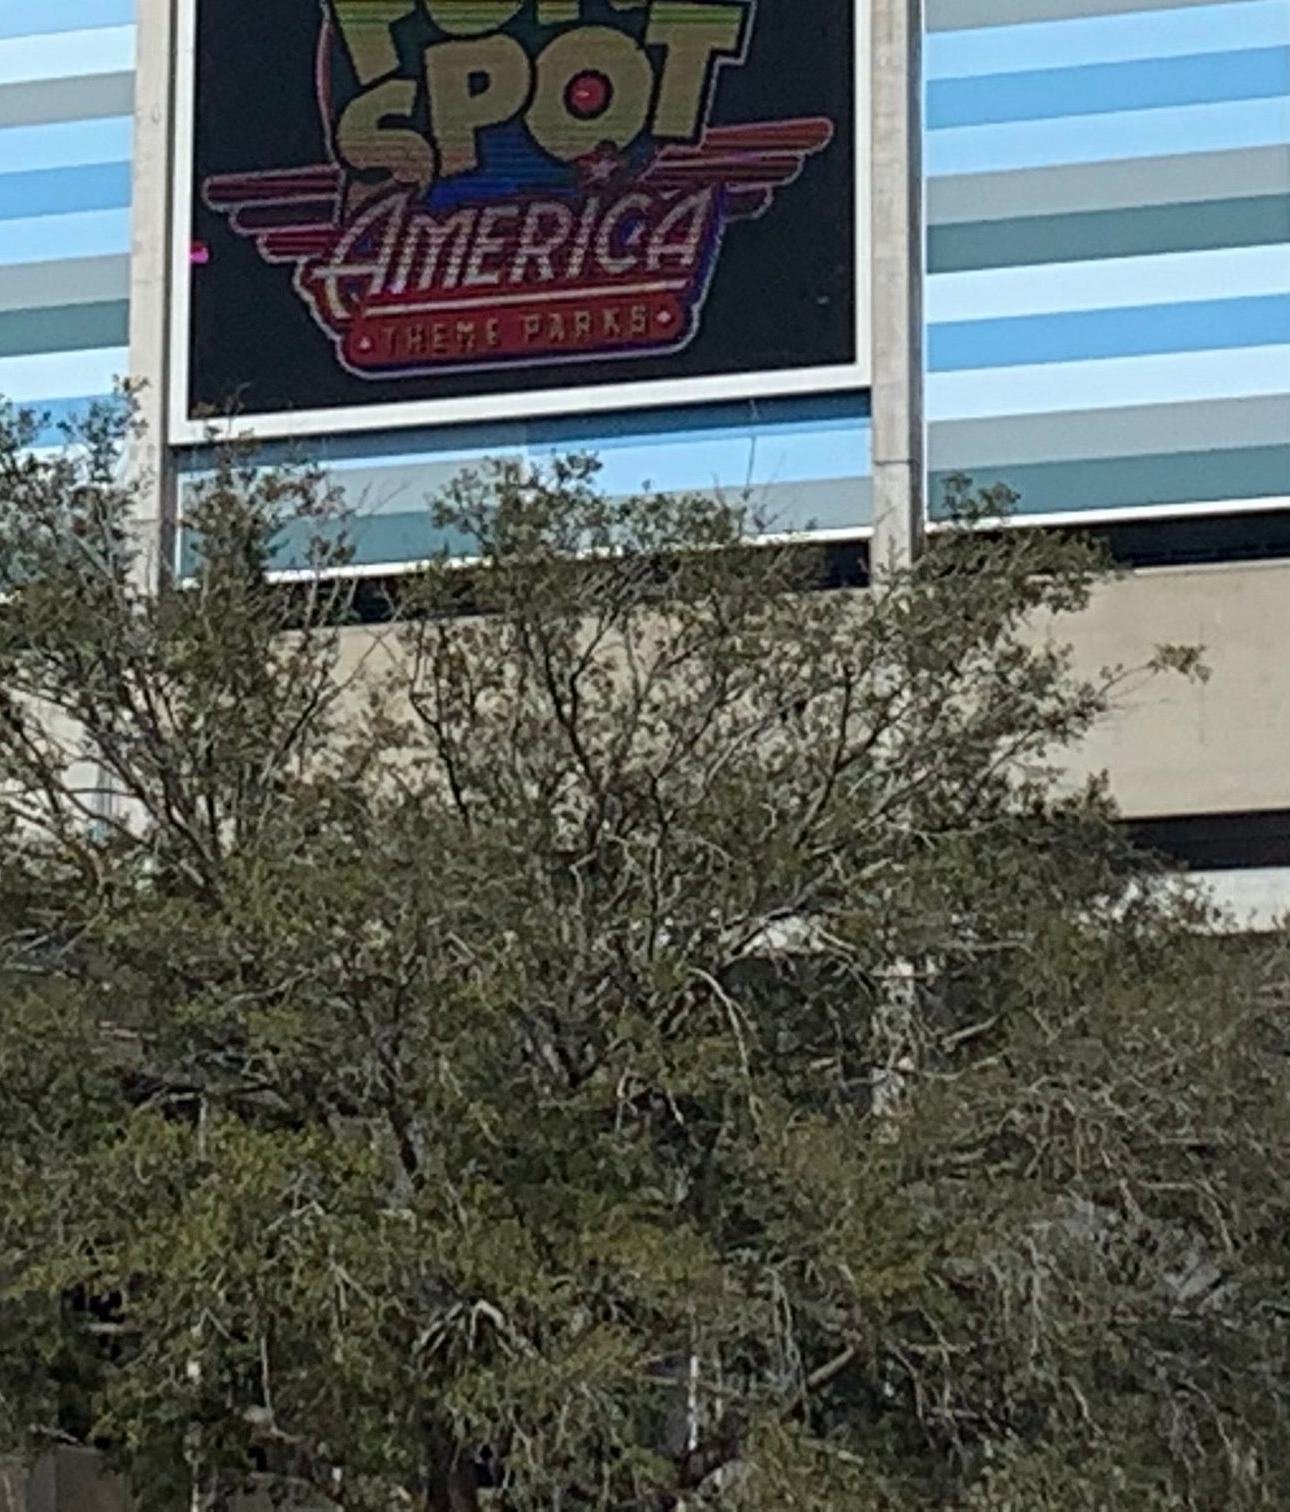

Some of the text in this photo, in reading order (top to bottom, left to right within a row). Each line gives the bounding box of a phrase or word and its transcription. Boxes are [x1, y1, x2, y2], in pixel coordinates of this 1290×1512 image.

[336, 0, 744, 203] SPOT
[311, 191, 712, 317] AMERICA
[381, 303, 650, 357] THEME PARKS
